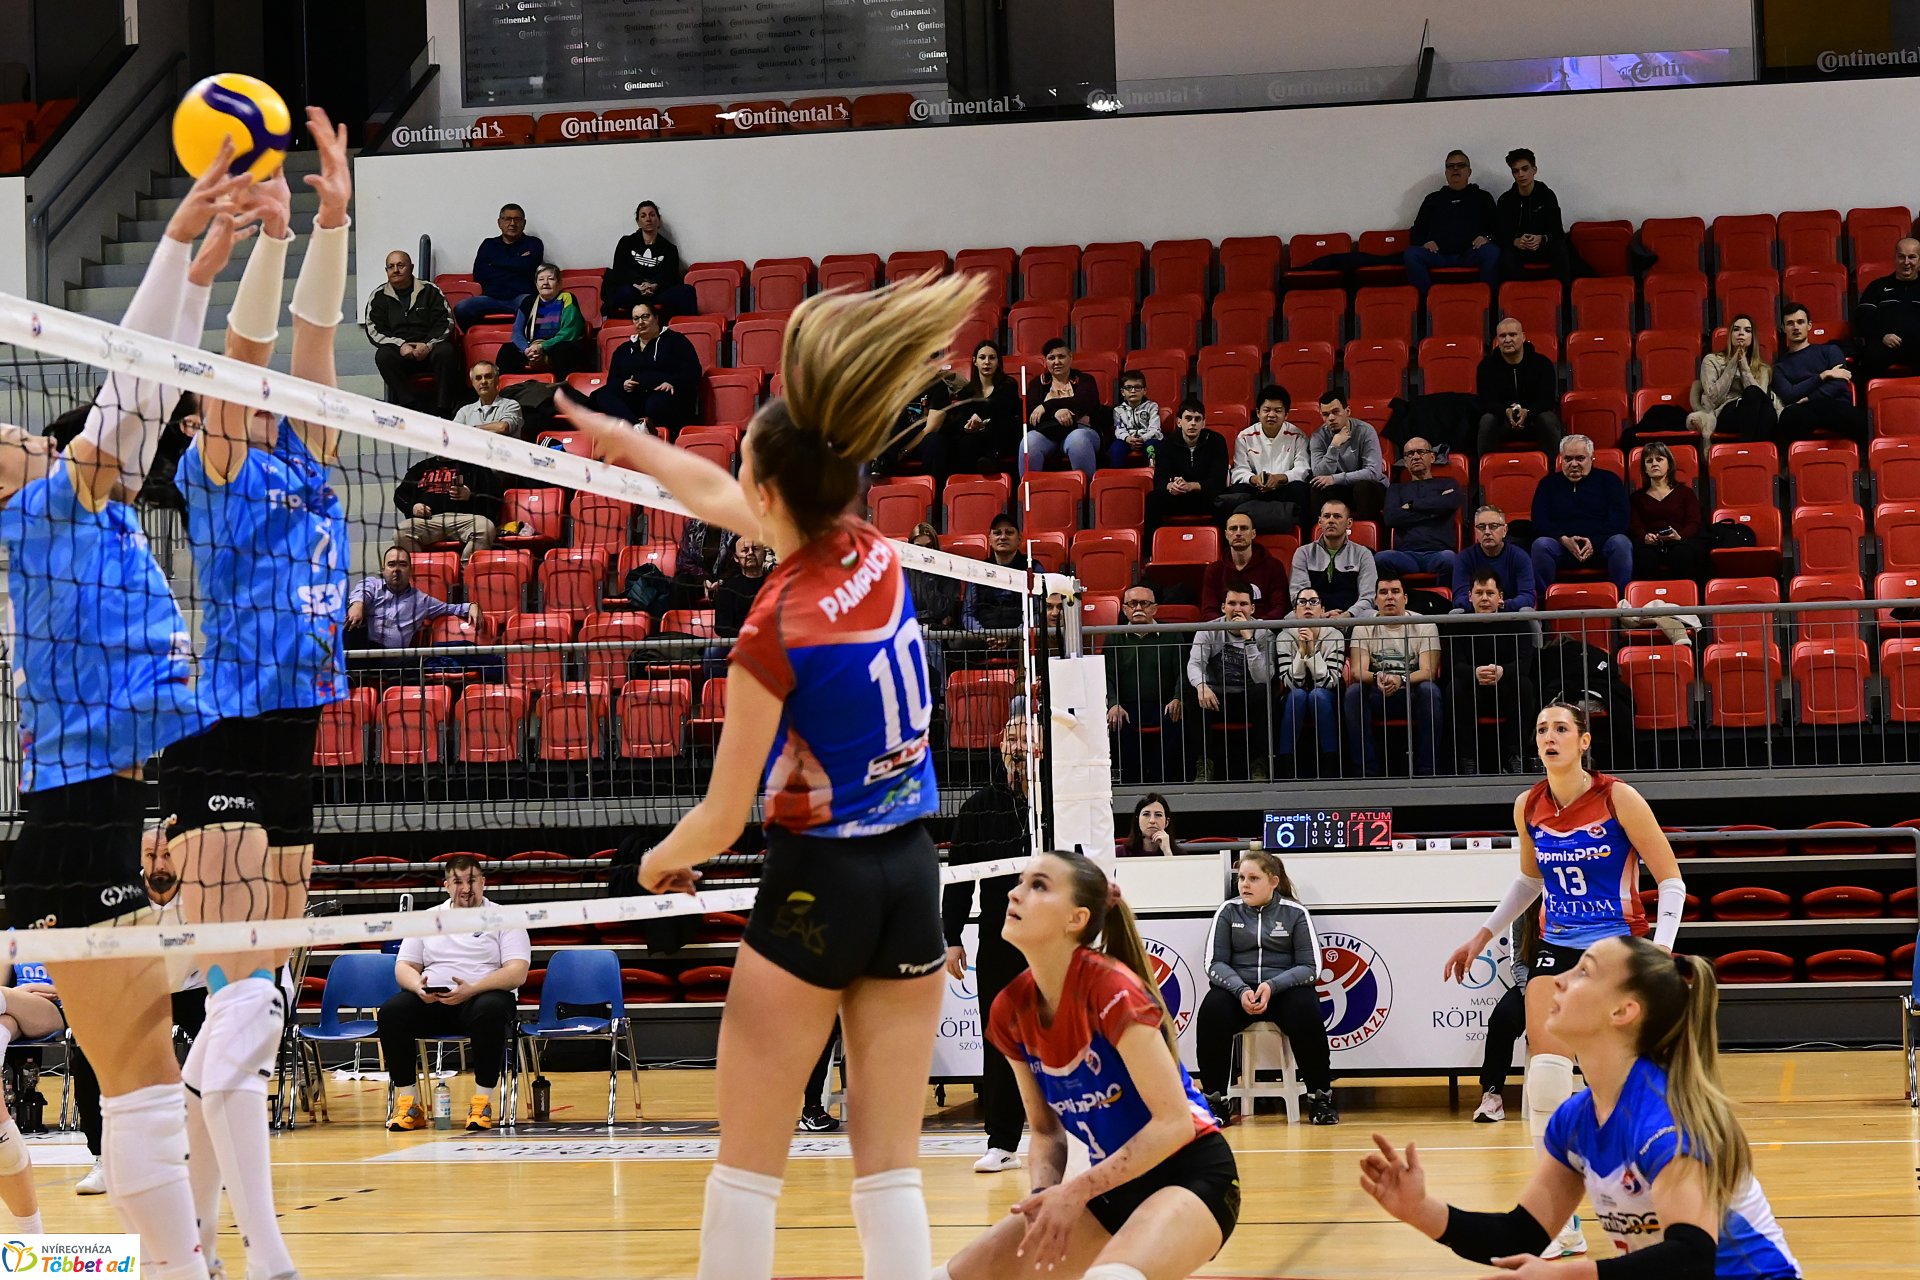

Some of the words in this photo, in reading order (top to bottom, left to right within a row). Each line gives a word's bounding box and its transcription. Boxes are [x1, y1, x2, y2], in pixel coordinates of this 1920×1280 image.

[890, 7, 931, 19] Continental
[624, 81, 664, 92] Continental
[391, 122, 489, 148] Continental
[560, 113, 658, 139] Continental
[734, 104, 833, 130] Continental
[909, 95, 1010, 121] Continental
[818, 539, 893, 624] PAMPUCH
[868, 617, 933, 751] 10
[1265, 813, 1312, 822] Benedek
[1350, 811, 1391, 820] FATUM
[1276, 823, 1295, 848] 6
[1352, 821, 1389, 847] 12
[1552, 866, 1588, 896] 13
[1548, 894, 1616, 913] FATUM
[1319, 935, 1361, 953] TUM
[1536, 957, 1556, 968] 13
[1470, 997, 1500, 1006] MAGY
[1330, 1007, 1388, 1048] GYHAZA
[1432, 1006, 1489, 1028] RÖPL
